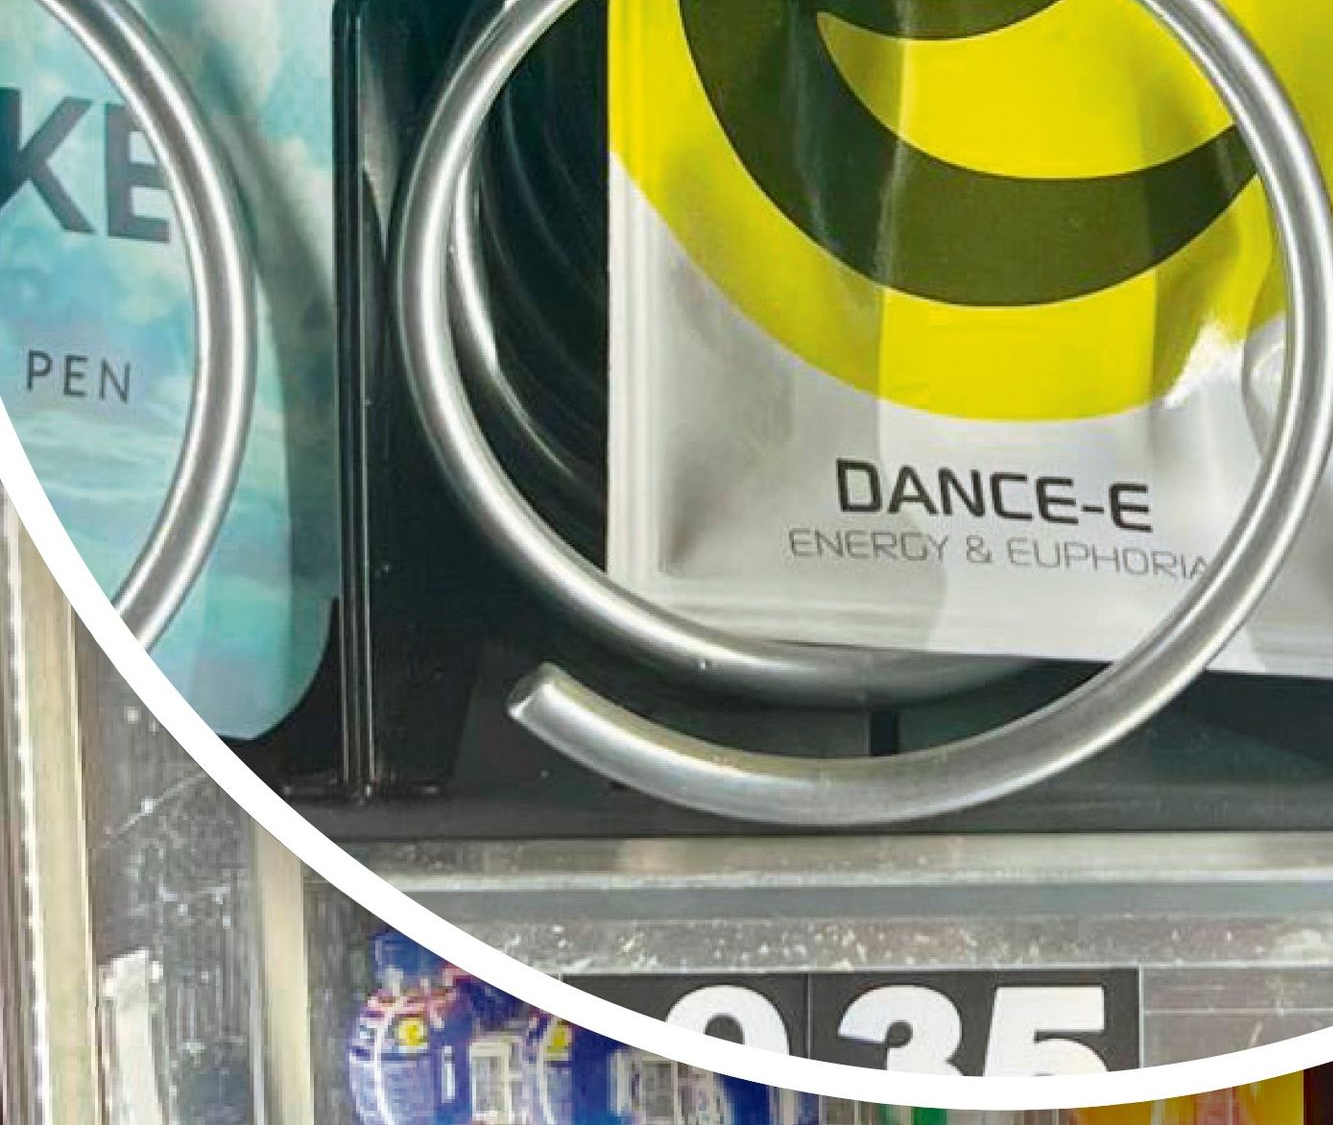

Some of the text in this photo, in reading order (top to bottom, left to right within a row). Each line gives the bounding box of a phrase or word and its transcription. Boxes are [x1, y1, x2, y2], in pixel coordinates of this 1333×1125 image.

[26, 350, 133, 403] PEN
[835, 457, 1154, 533] DANCE-E
[788, 527, 1211, 580] ENERGY & EUPHORIA
